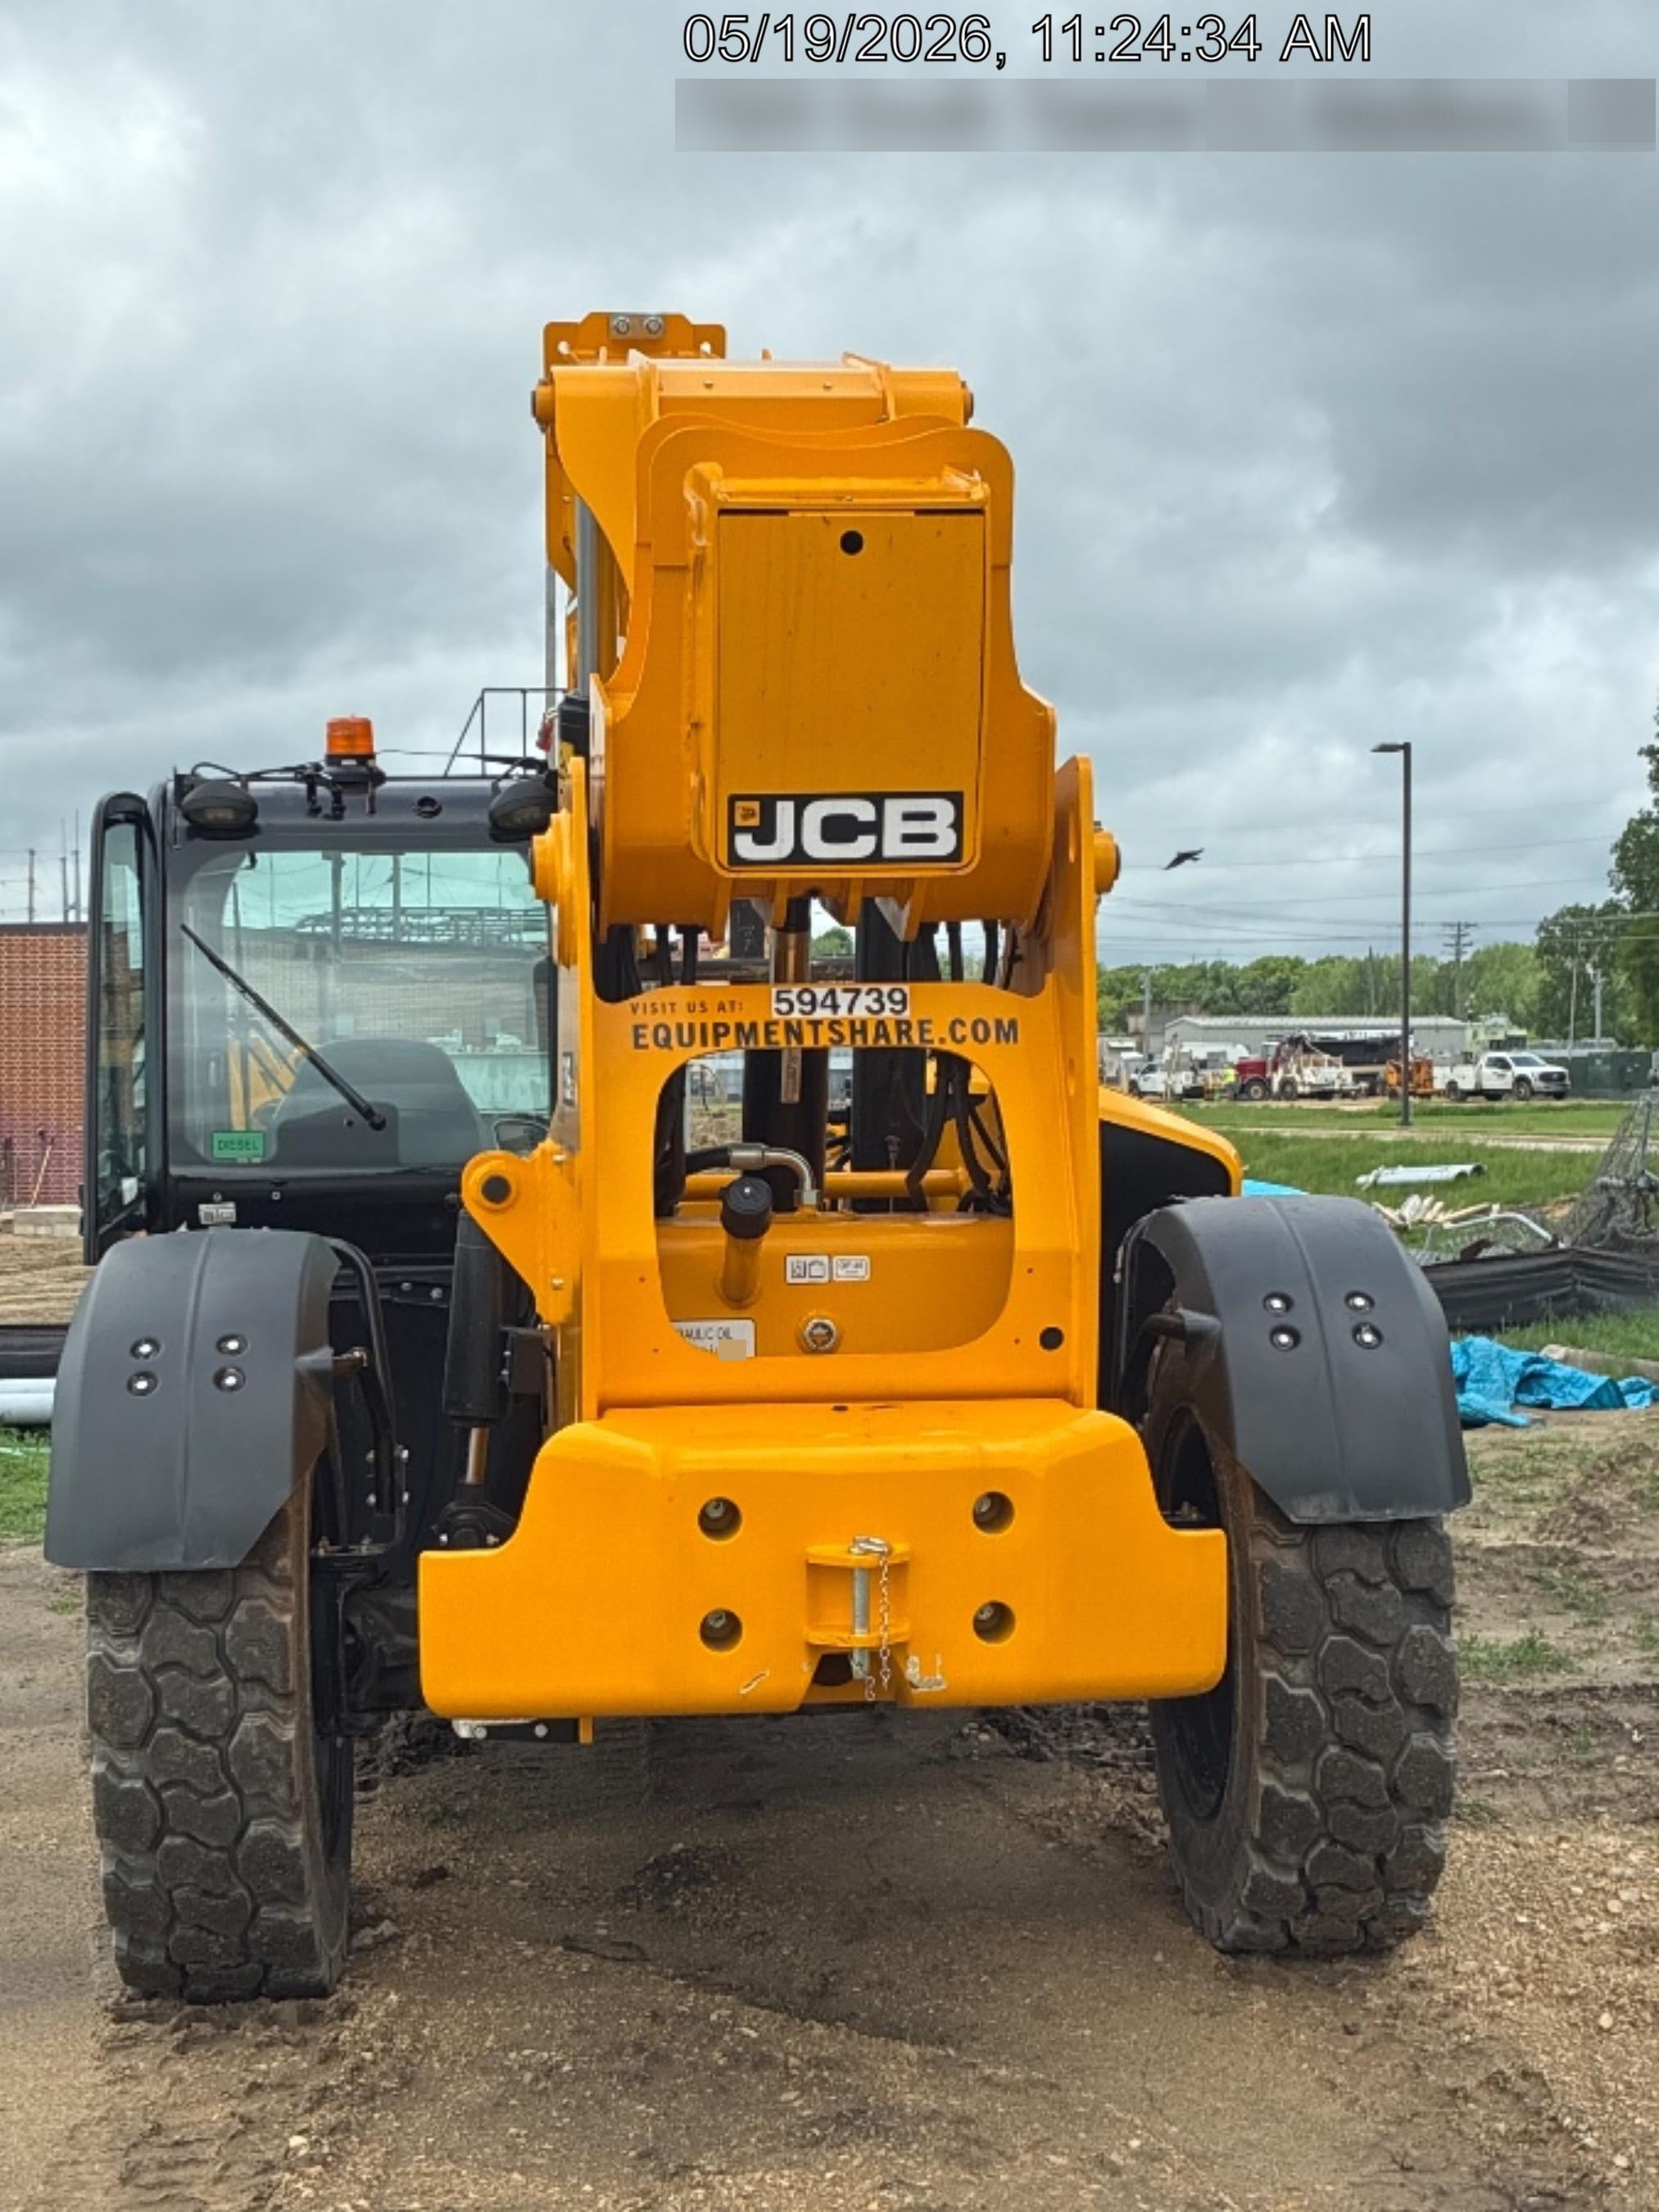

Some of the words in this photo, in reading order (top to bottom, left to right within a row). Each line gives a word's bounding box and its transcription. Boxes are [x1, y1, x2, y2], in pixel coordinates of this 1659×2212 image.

[734, 798, 958, 861] JCB
[630, 1002, 677, 1014] VISIT
[687, 1001, 709, 1013] US
[717, 999, 743, 1013] AT:
[773, 987, 909, 1015] 594739
[632, 1017, 1018, 1050] EQUIPMENTSHARE.COM
[218, 1140, 259, 1151] DIESEL
